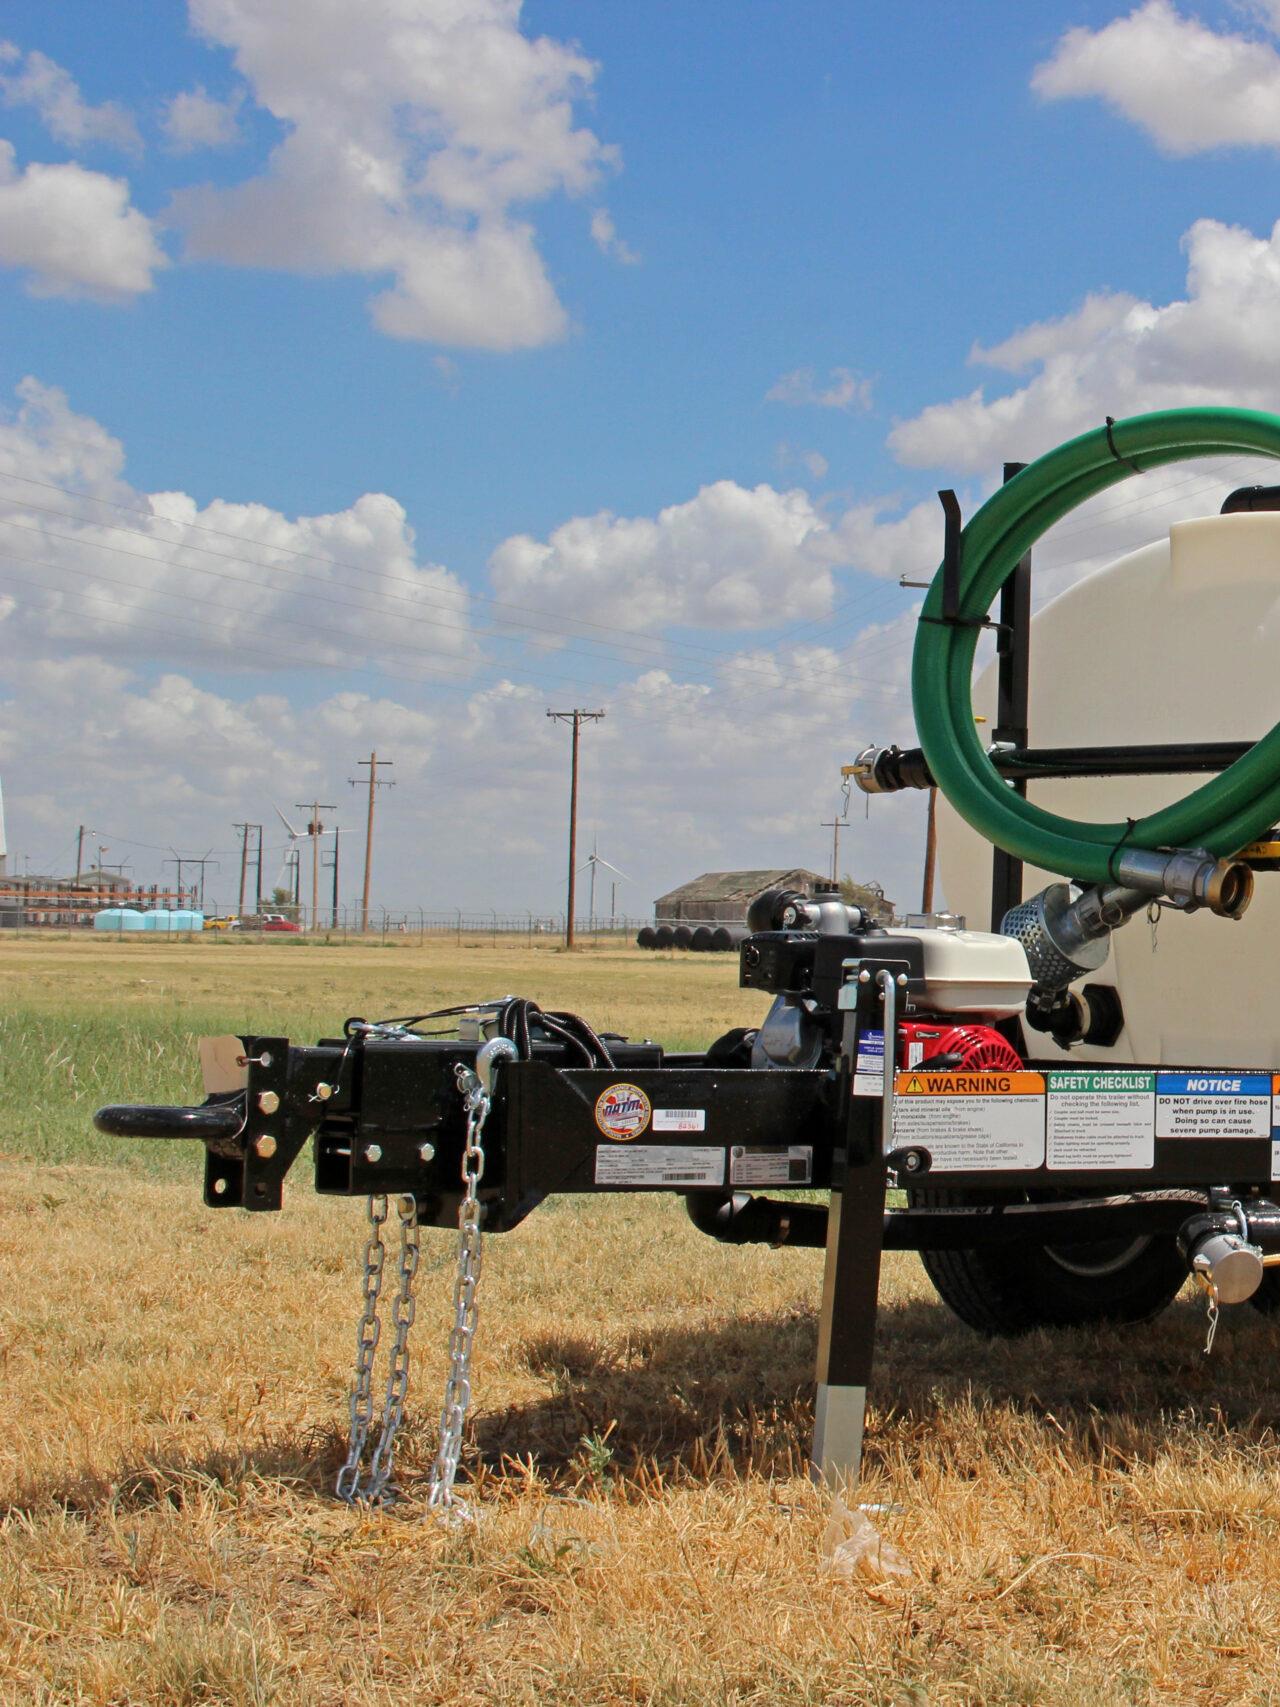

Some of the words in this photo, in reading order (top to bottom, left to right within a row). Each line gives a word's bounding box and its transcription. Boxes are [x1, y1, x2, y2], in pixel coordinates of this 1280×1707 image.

[927, 1078, 1010, 1092] WARNING
[1050, 1077, 1089, 1088] SAFETY
[1093, 1077, 1151, 1088] CHECKLIST
[1187, 1079, 1241, 1091] NOTICE
